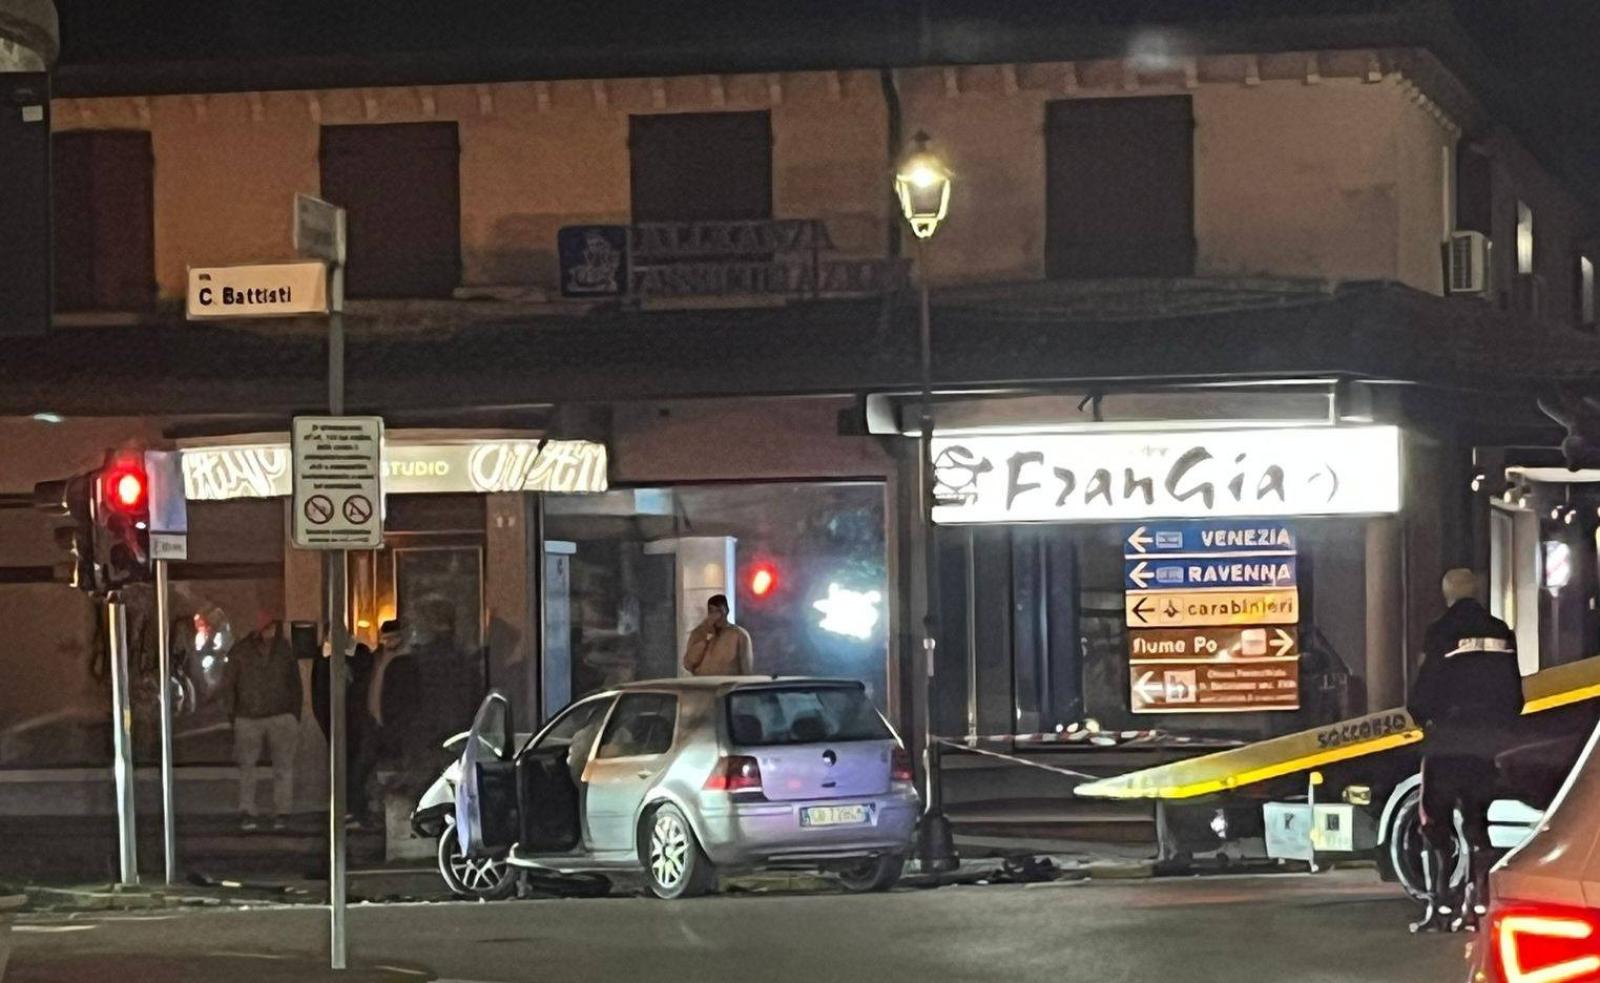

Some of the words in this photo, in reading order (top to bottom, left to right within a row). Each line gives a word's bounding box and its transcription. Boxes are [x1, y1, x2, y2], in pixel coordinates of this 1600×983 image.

[222, 285, 292, 305] Battisti
[1201, 528, 1291, 547] VENEZIA
[1188, 564, 1292, 583] RAVENNA
[1188, 598, 1293, 616] carabinieri
[1133, 637, 1186, 654] fiume
[1194, 636, 1218, 653] Po
